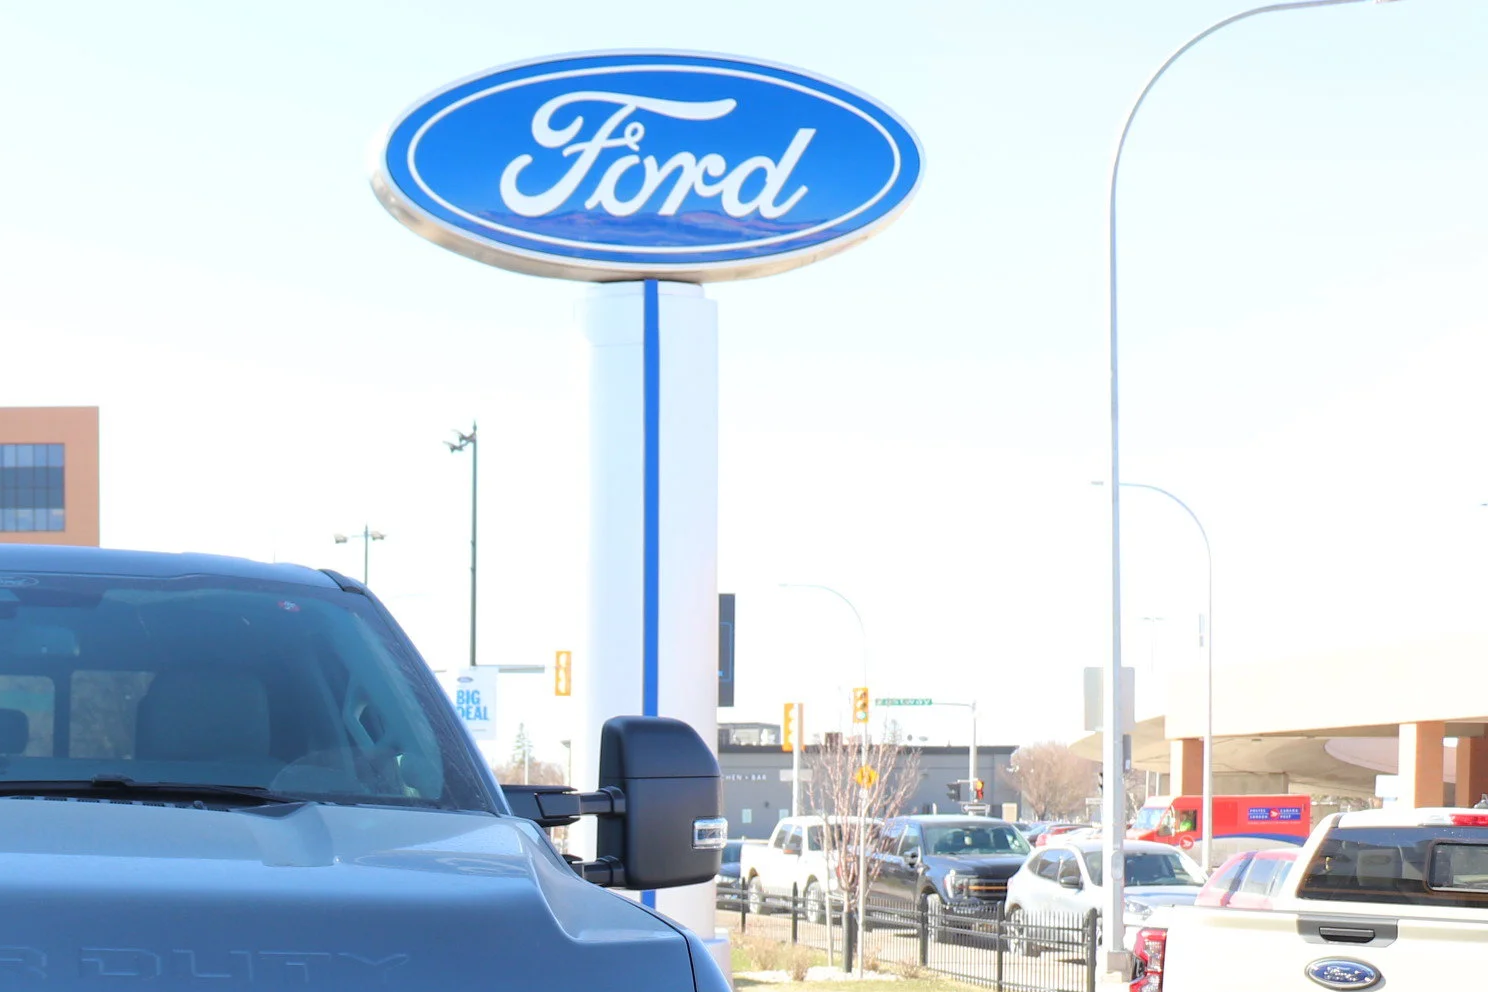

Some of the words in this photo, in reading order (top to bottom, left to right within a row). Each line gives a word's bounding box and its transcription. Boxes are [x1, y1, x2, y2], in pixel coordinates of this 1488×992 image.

[500, 91, 817, 219] Ford
[456, 690, 480, 705] BIG
[80, 946, 410, 984] DUTY
